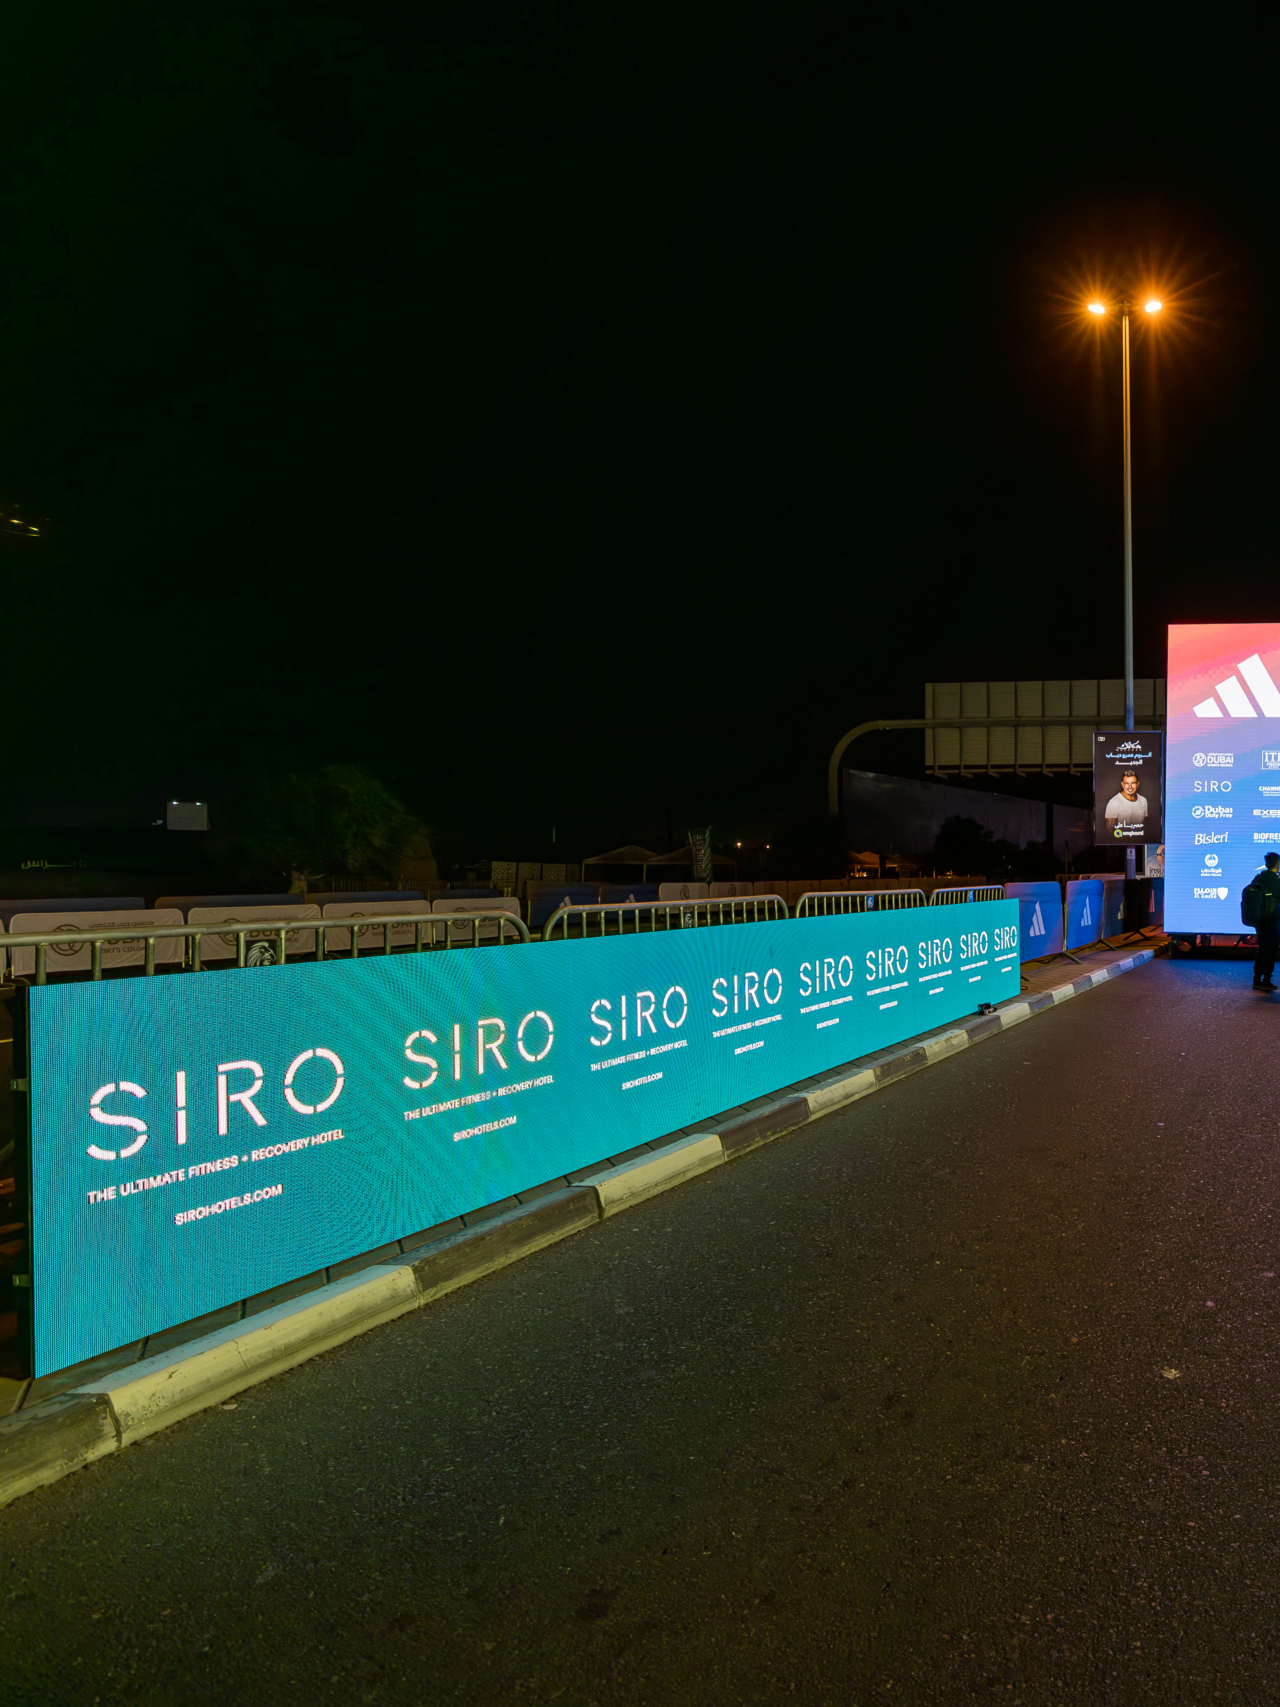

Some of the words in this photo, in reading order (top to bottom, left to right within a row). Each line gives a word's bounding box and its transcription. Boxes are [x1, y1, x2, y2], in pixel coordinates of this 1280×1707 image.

[1207, 756, 1234, 764] DUBAI
[1193, 780, 1232, 793] SIRO
[1194, 831, 1229, 845] Bisleri
[918, 937, 953, 969] SIRO
[960, 931, 988, 959] SIRO
[994, 925, 1018, 951] SIRO
[799, 954, 854, 997] SIRO
[865, 945, 909, 981] SIRO
[711, 967, 783, 1018] SIRO
[589, 985, 688, 1047] SIRO
[403, 1010, 554, 1090] SIRO
[87, 1048, 345, 1161] SIRO
[403, 1109, 420, 1121] THE
[421, 1098, 460, 1117] ULTIMATE
[460, 1090, 491, 1107] FITNESS
[497, 1081, 533, 1097] RECOVERY
[534, 1075, 554, 1087] HOTEL
[453, 1115, 517, 1142] SIROHOTELS.COM
[87, 1186, 117, 1205] THE
[119, 1168, 186, 1197] ULTIMATE
[188, 1154, 239, 1180] FITNESS
[251, 1136, 310, 1162] RECOVERY
[311, 1129, 344, 1147] HOTEL
[174, 1183, 283, 1226] SIROHOTELS.COM
